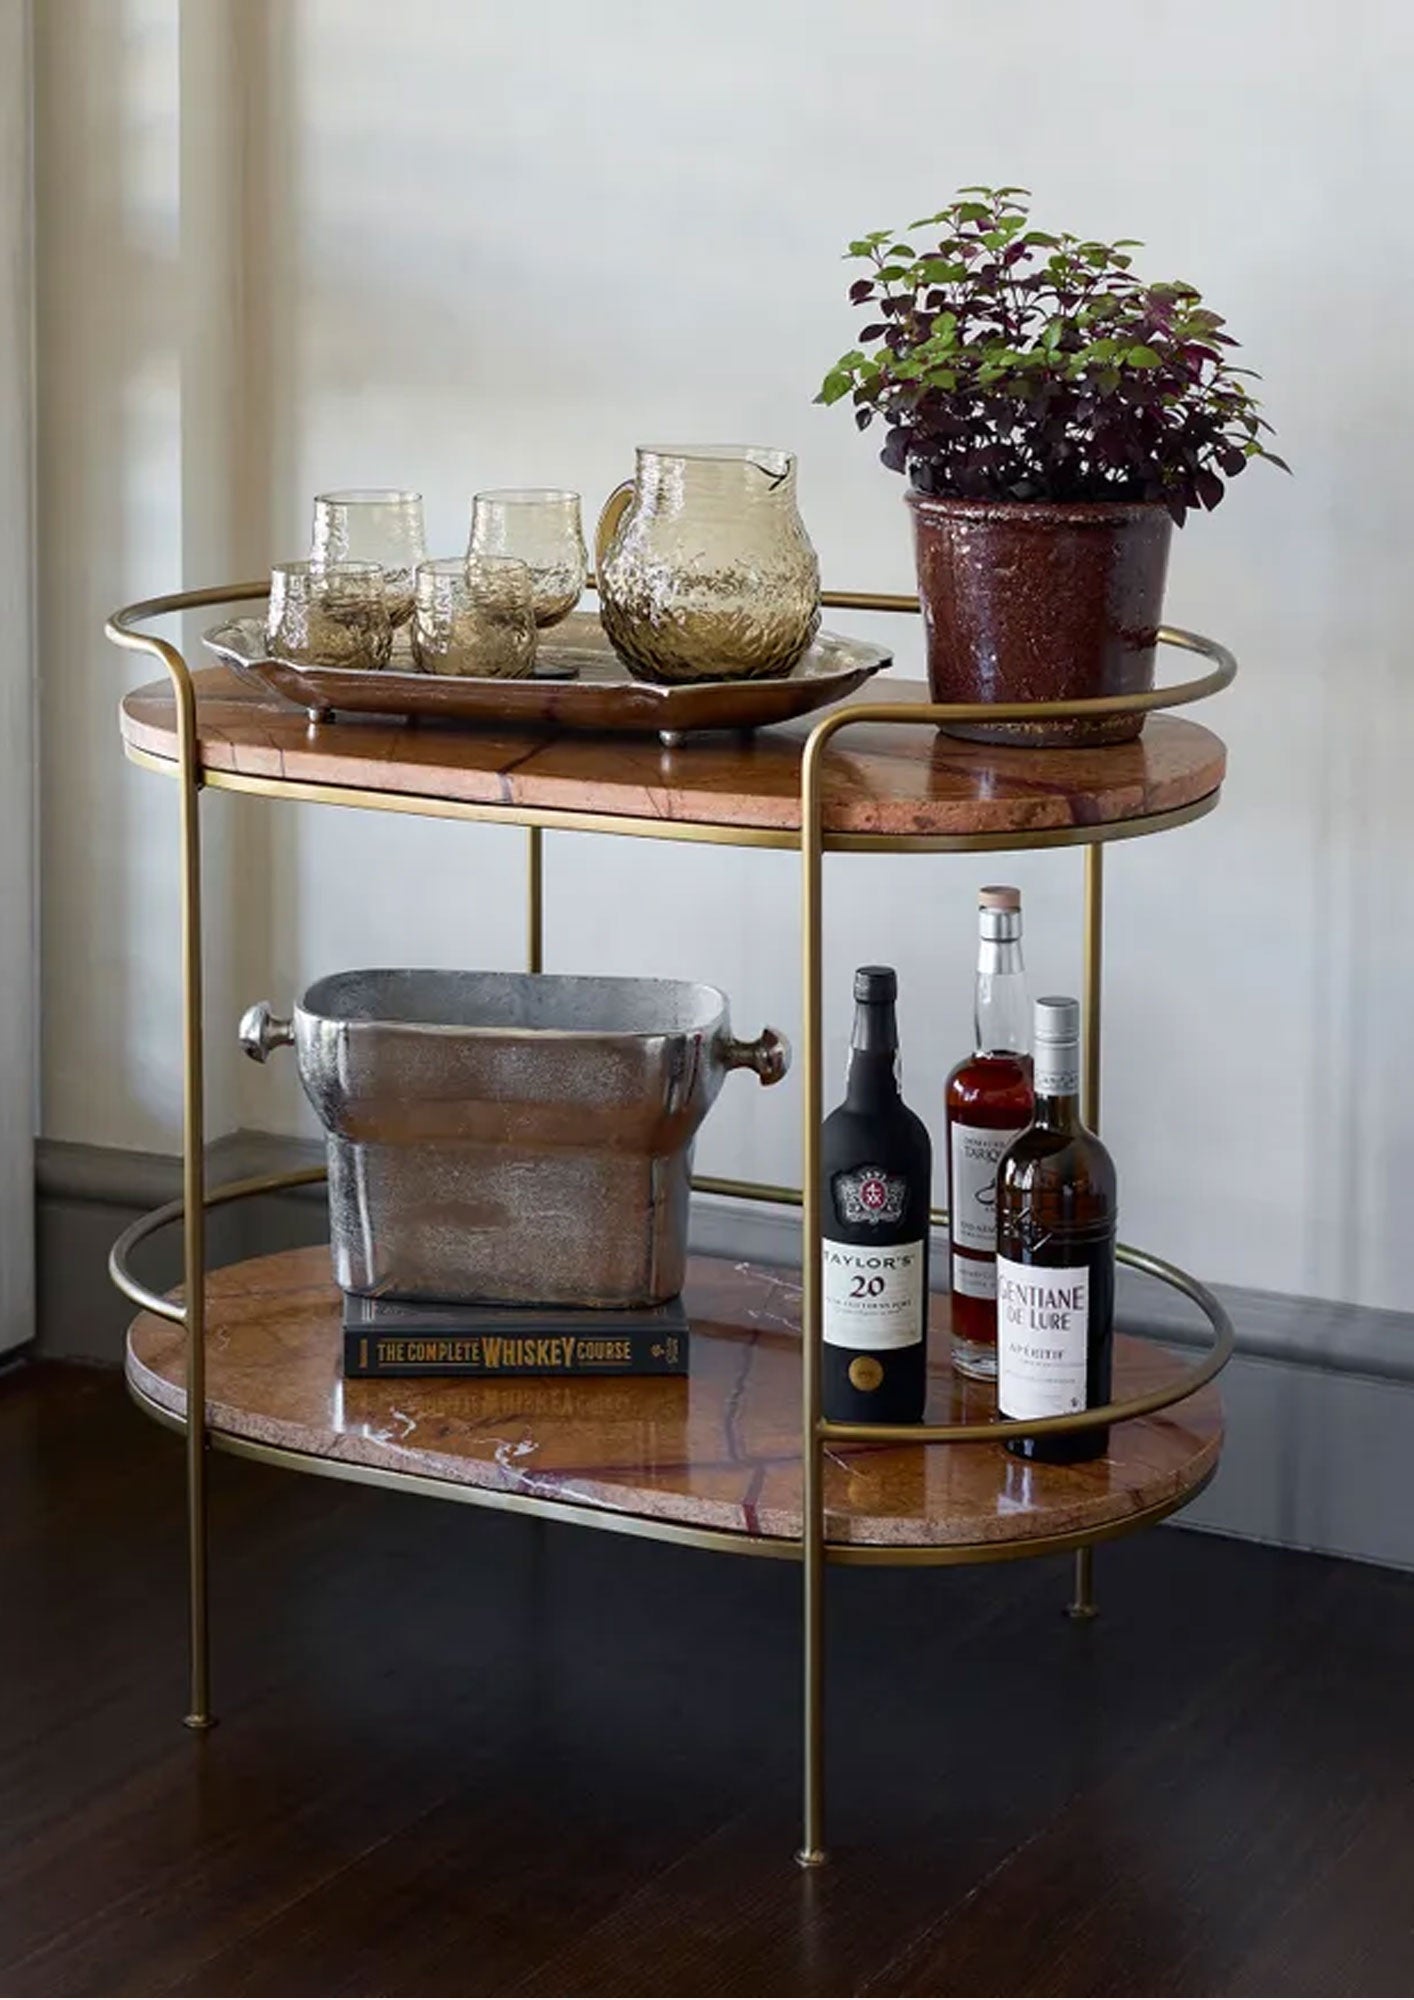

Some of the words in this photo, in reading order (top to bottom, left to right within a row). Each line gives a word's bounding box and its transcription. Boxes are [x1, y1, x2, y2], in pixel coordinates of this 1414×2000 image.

[849, 1275, 885, 1299] 20
[999, 1274, 1085, 1311] GENTIANE
[1006, 1305, 1023, 1325] DE
[1030, 1308, 1072, 1332] LURE
[377, 1343, 405, 1362] THE
[407, 1341, 480, 1362] COMPLETE
[481, 1336, 575, 1369] WHISKEY
[576, 1341, 632, 1360] COURSE
